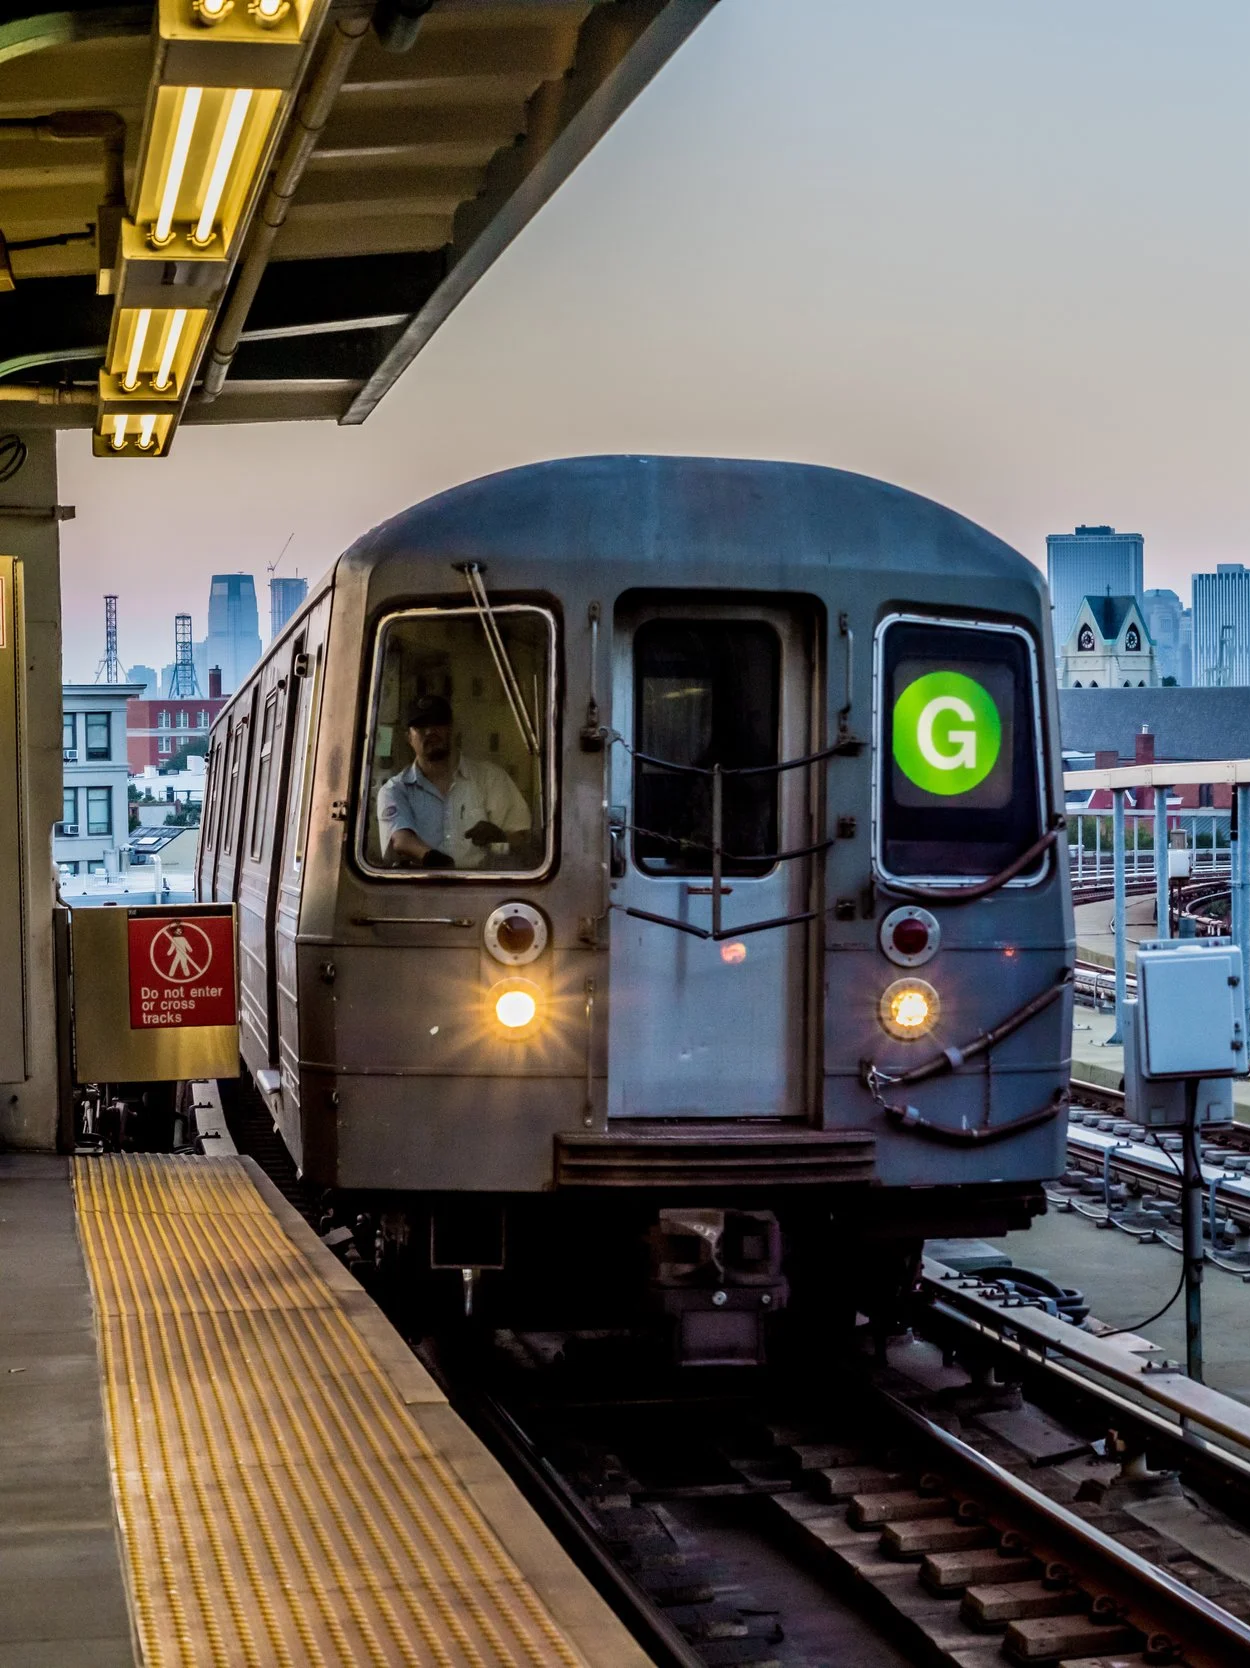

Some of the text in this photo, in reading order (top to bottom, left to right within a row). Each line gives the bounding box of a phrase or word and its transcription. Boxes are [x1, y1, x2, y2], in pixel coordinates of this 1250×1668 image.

[917, 696, 976, 770] G
[141, 985, 223, 999] Do not enter
[141, 1000, 196, 1011] or cross
[142, 1011, 182, 1024] tracks
